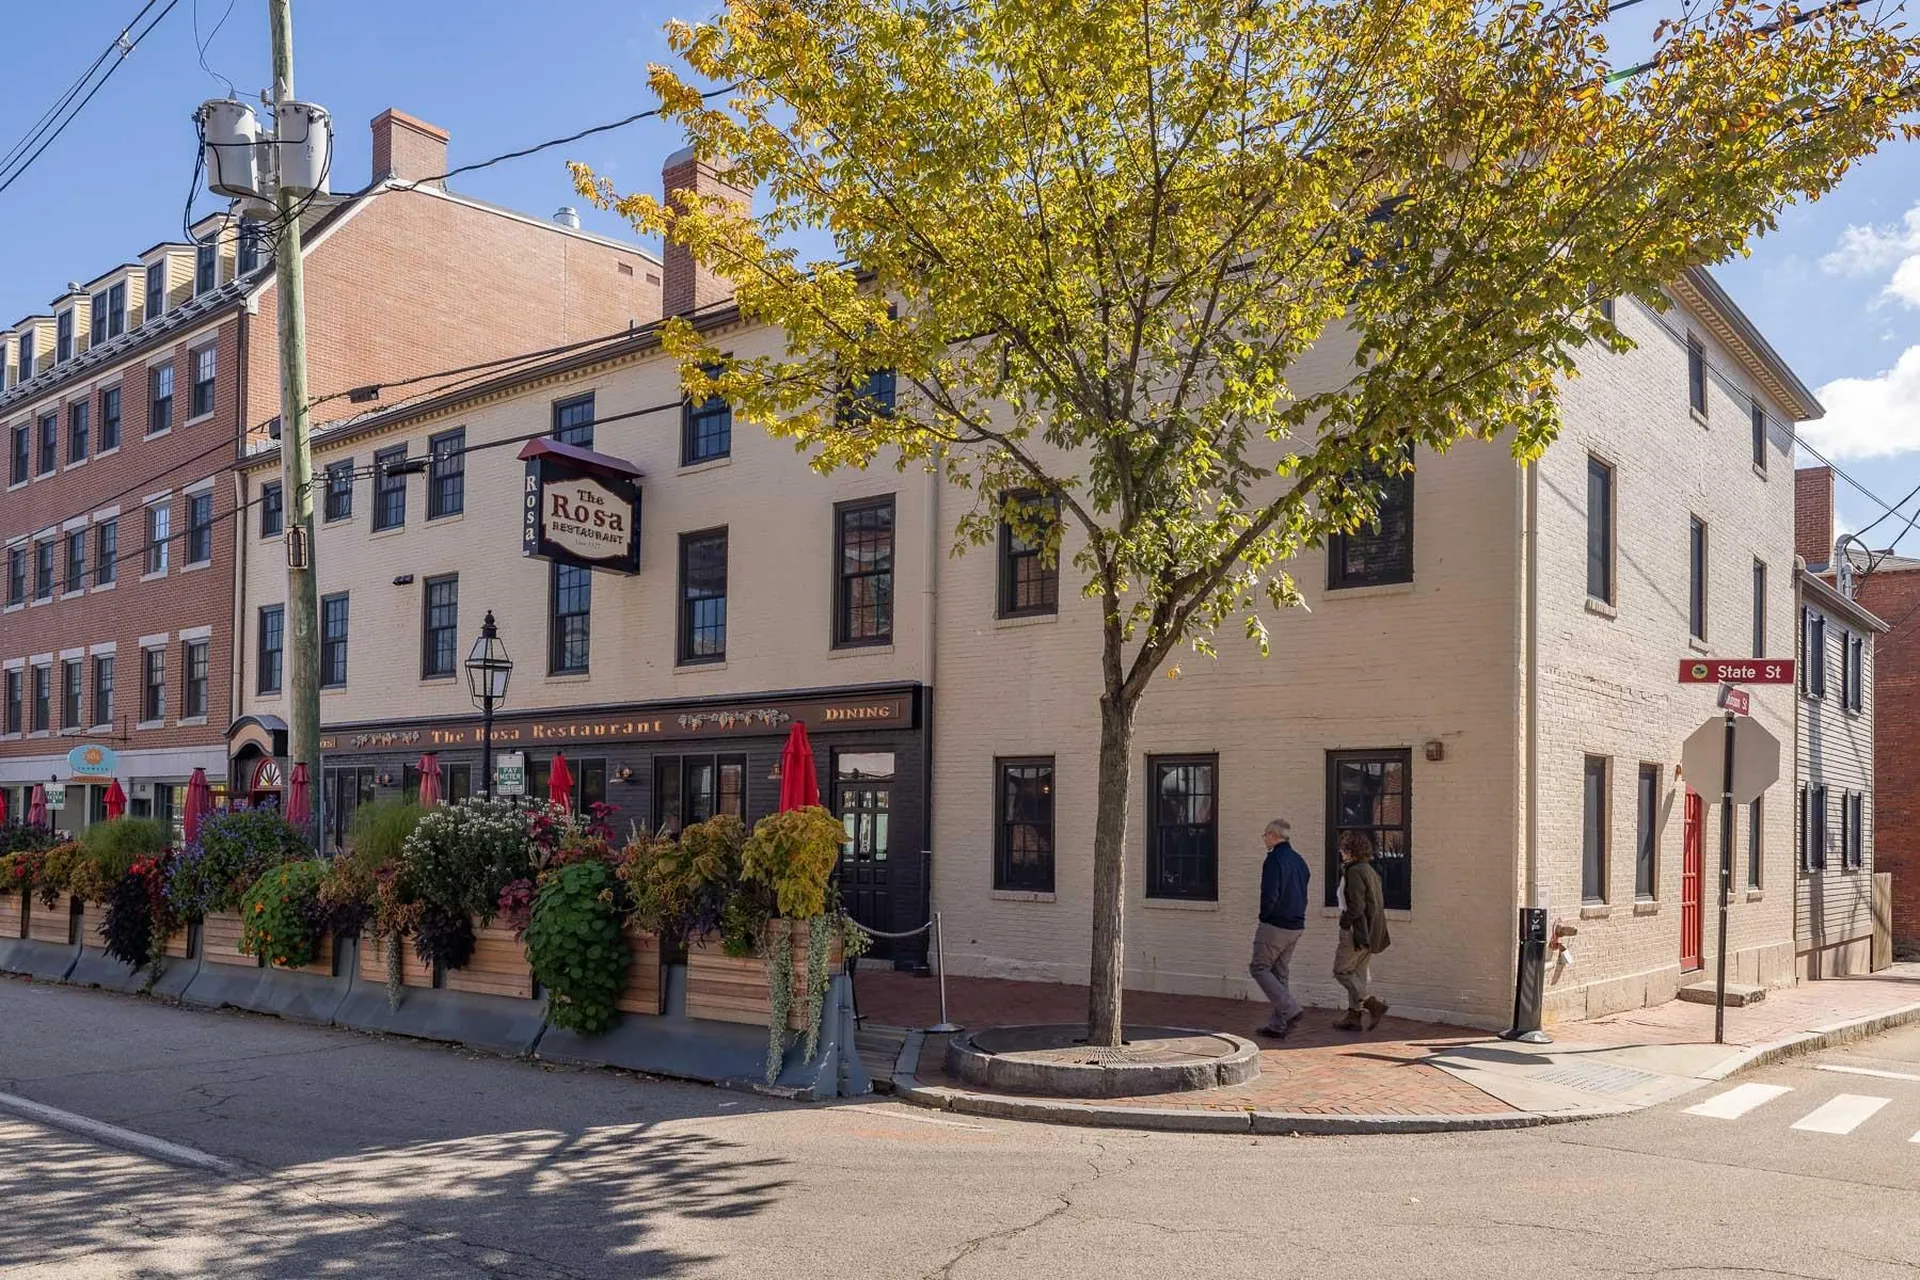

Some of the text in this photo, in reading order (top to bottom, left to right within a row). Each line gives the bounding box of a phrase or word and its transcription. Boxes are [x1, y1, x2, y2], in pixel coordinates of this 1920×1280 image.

[525, 475, 538, 541] Rosa
[577, 489, 605, 505] The
[551, 493, 625, 532] Rosa
[552, 521, 624, 544] RESTAURANT
[1717, 665, 1781, 679] State St
[825, 706, 889, 720] DINING
[431, 719, 664, 744] The Rosa Restaurant
